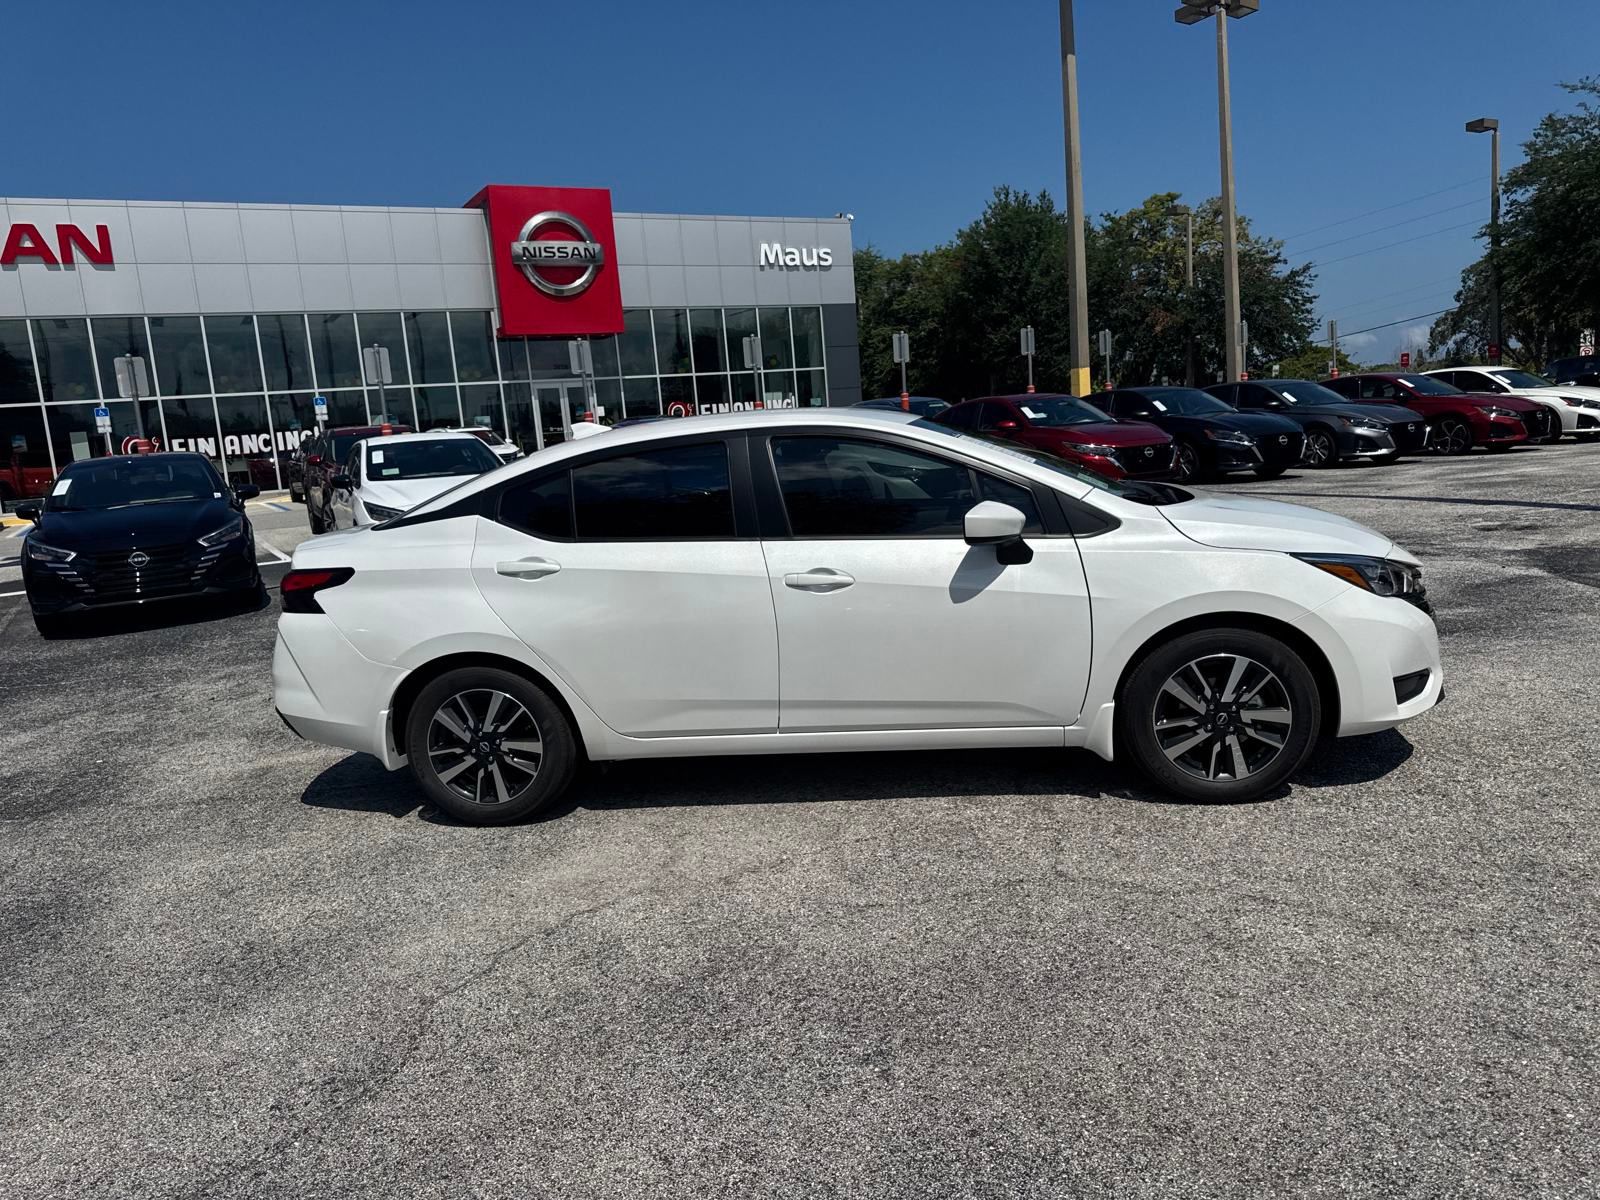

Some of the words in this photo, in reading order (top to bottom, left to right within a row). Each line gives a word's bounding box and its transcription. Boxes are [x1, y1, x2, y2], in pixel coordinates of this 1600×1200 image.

[0, 223, 114, 265] AN
[522, 246, 596, 259] NISSAN
[760, 243, 833, 266] Maus
